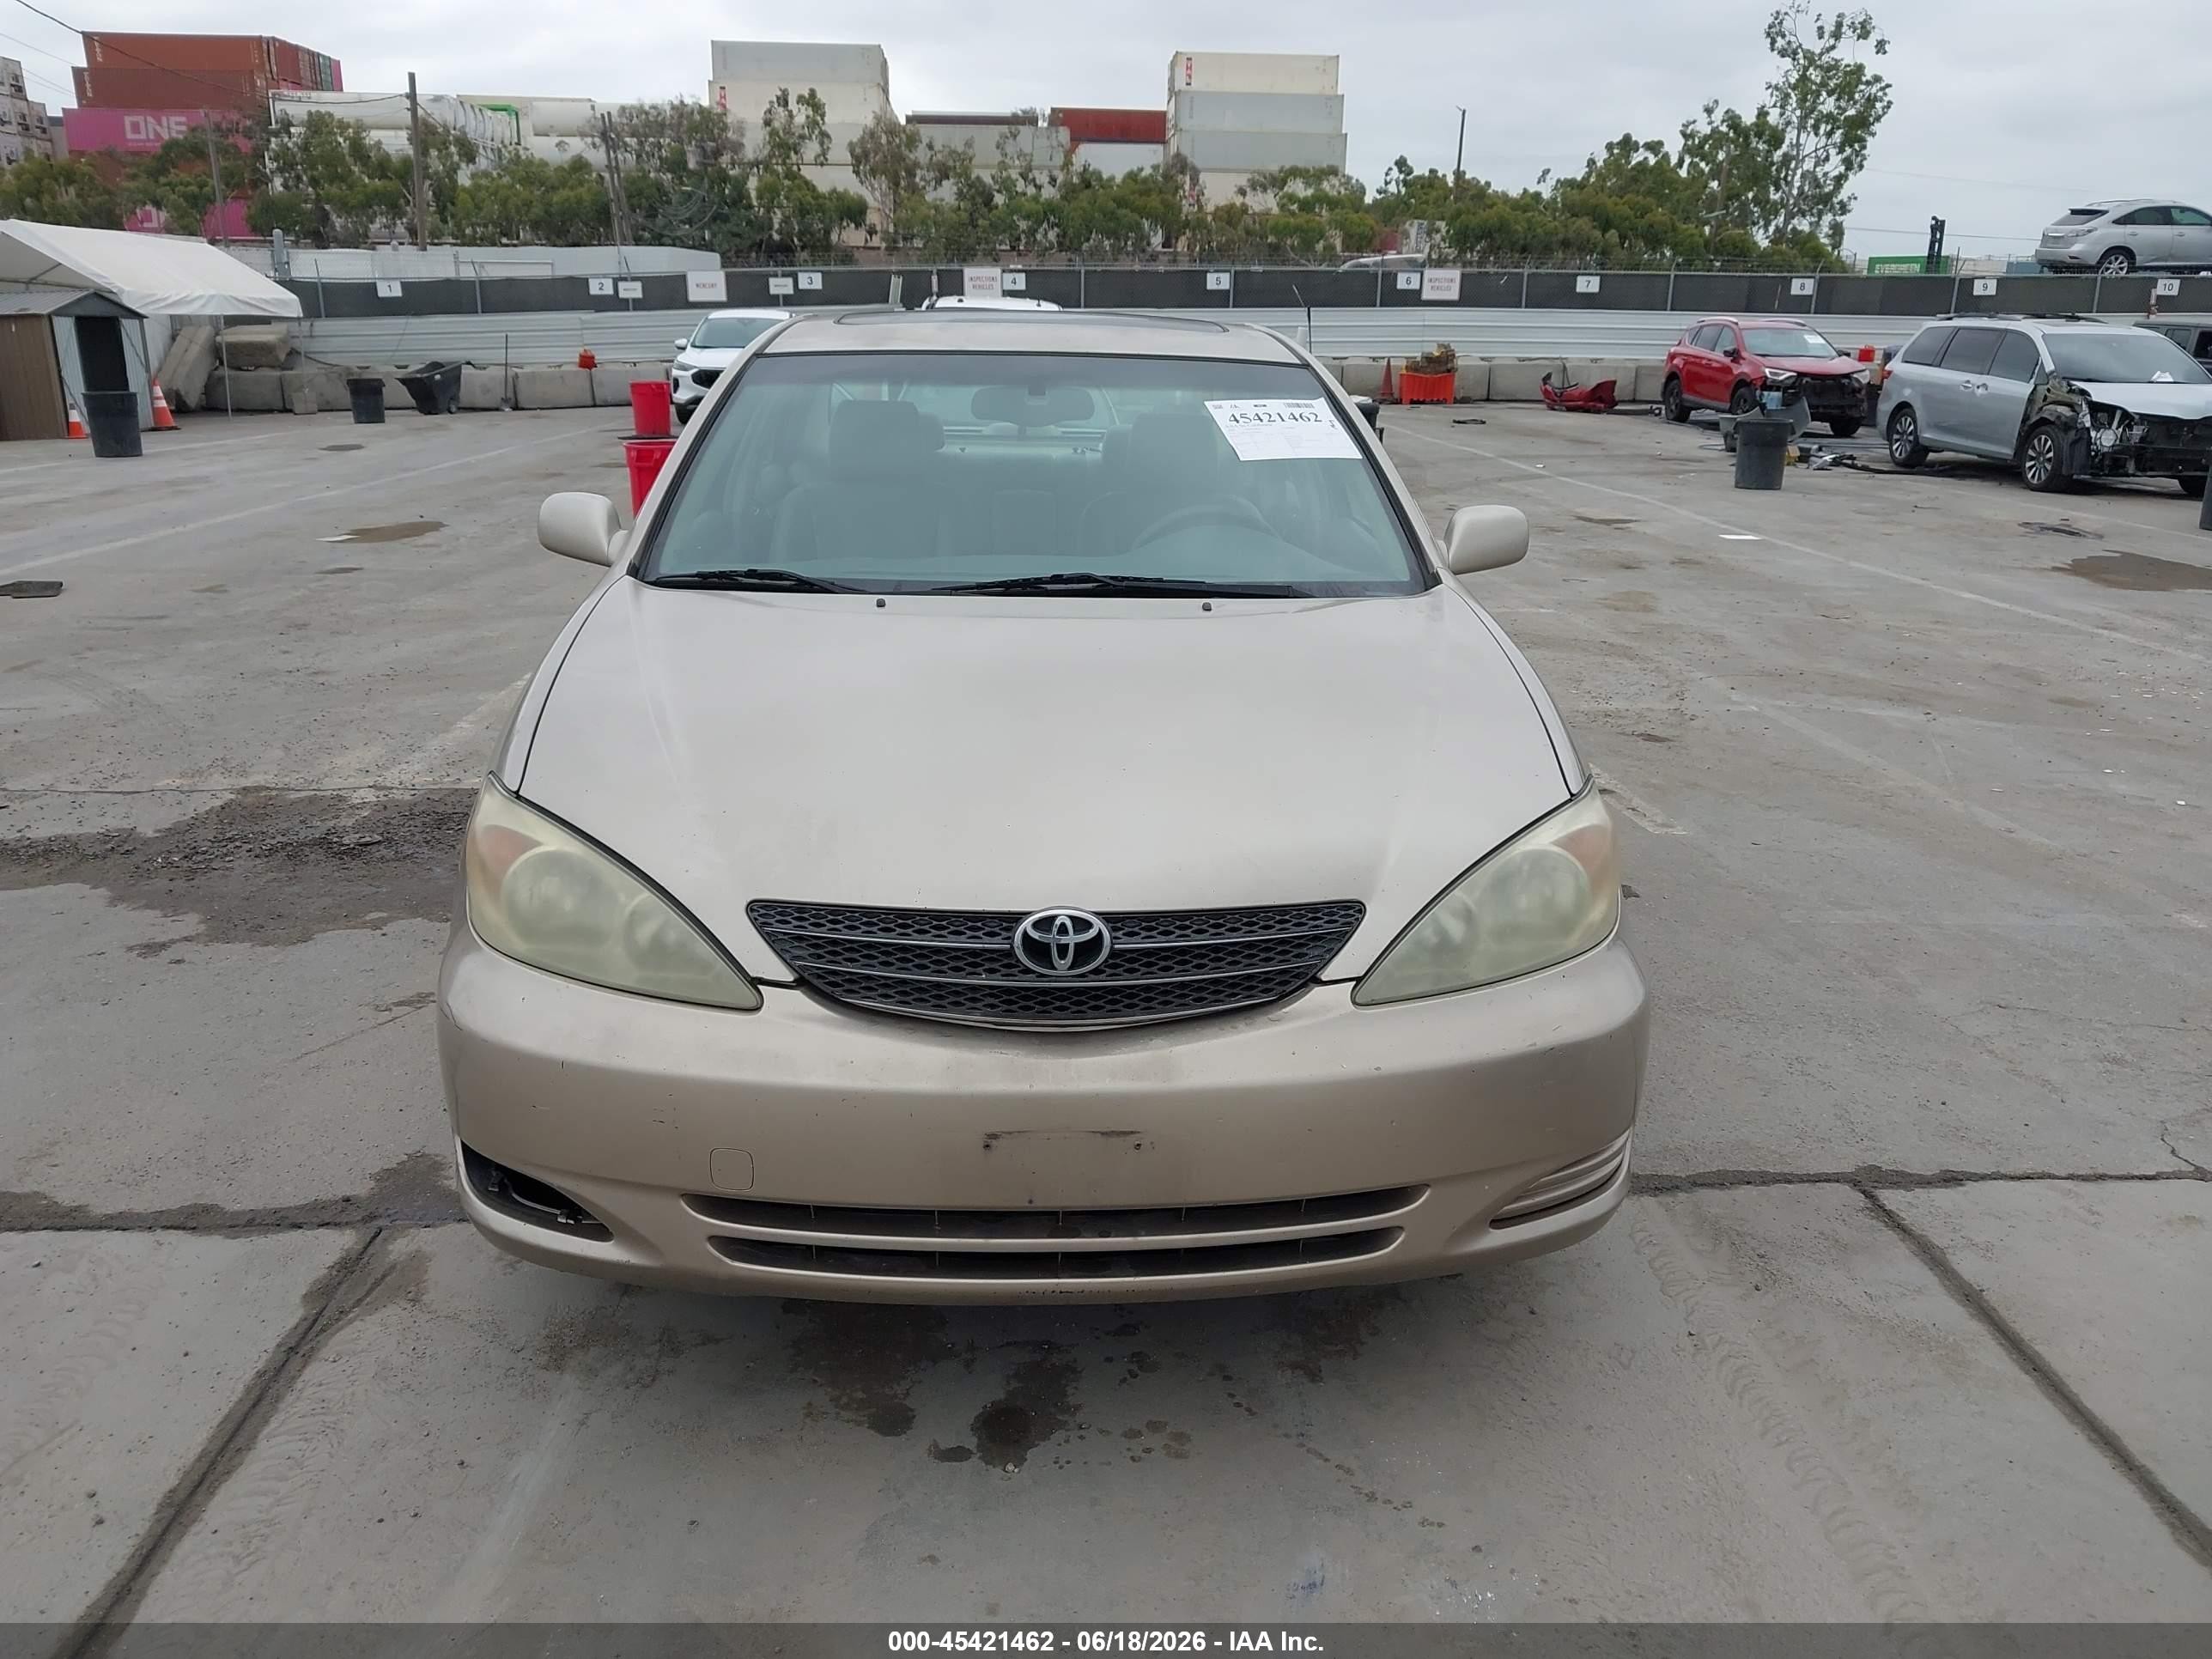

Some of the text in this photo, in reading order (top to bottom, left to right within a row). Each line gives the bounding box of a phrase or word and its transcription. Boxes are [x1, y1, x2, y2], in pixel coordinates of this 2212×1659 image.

[124, 115, 187, 140] ONE
[807, 276, 813, 285] 3
[1011, 276, 1017, 286] 4
[1215, 276, 1221, 286] 5
[1406, 276, 1412, 285] 6
[1585, 280, 1591, 289] 7
[387, 284, 392, 293] 1
[598, 282, 605, 291] 2
[1799, 282, 1806, 291] 8
[1982, 283, 1989, 291] 9
[2163, 283, 2173, 292] 10
[1229, 411, 1322, 424] 45421462
